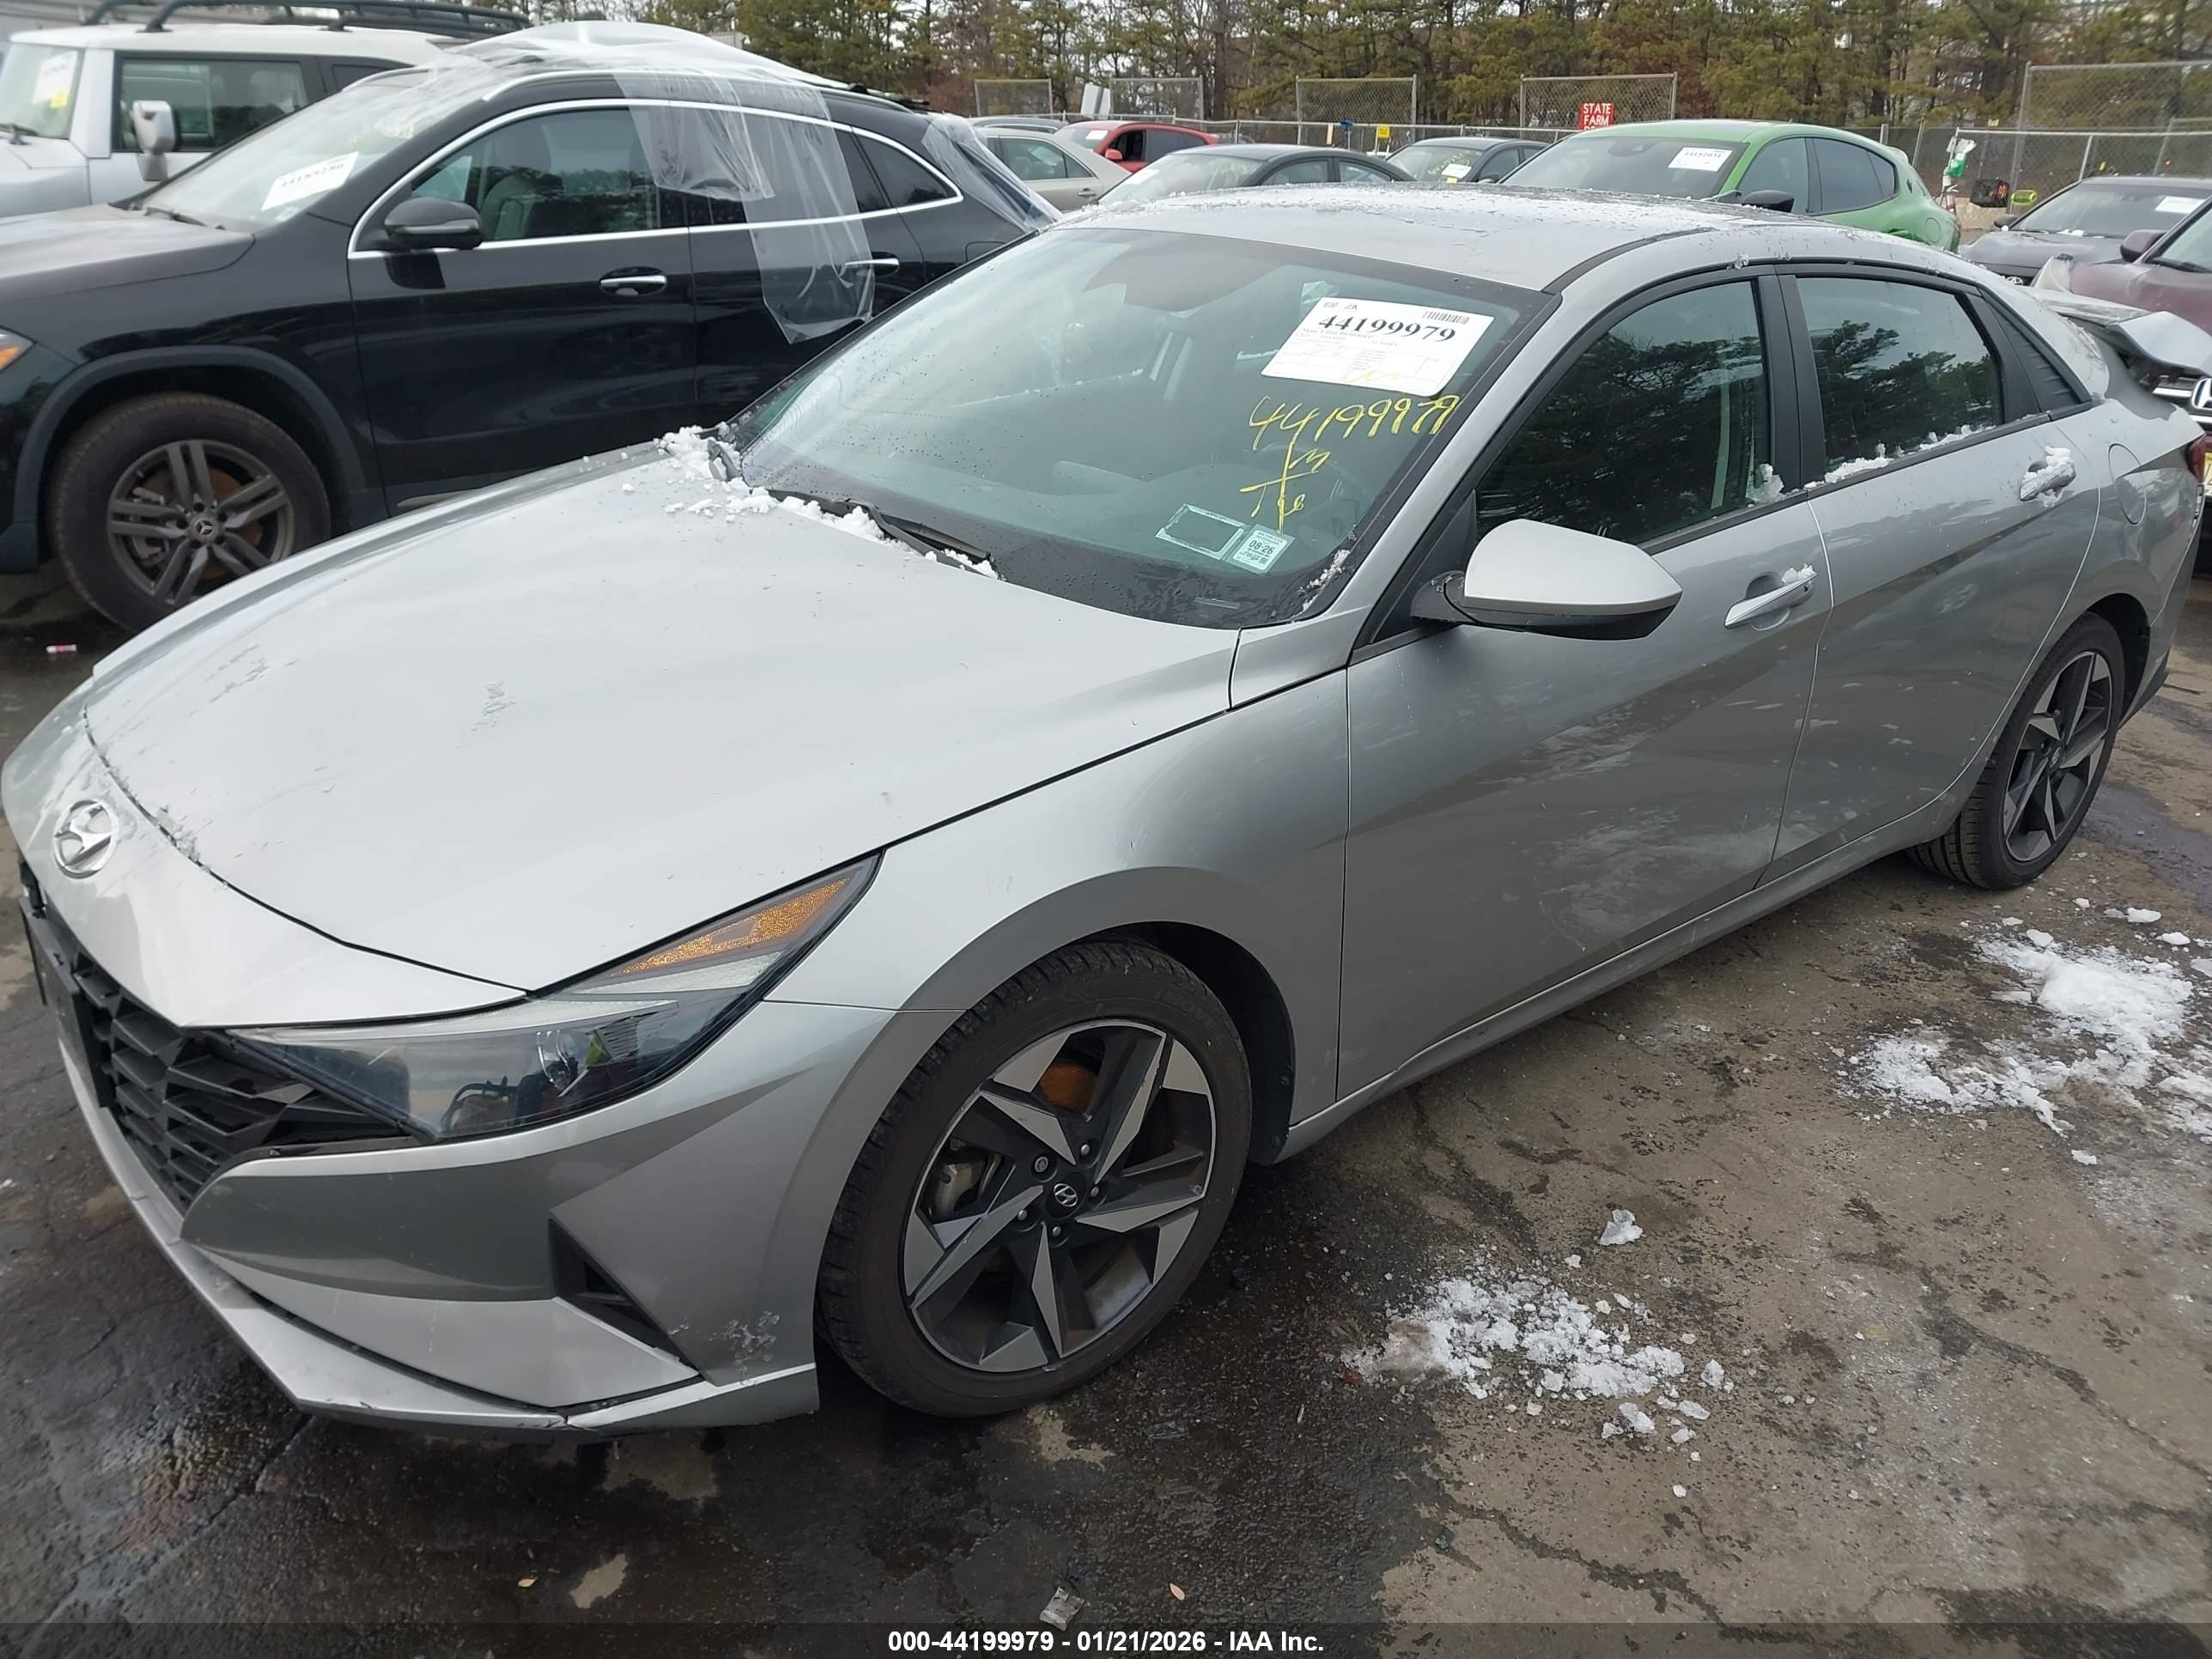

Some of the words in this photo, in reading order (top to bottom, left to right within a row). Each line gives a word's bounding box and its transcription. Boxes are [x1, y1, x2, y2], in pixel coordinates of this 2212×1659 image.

[1583, 102, 1612, 114] STATE
[1583, 114, 1610, 126] FARM
[1318, 313, 1456, 343] 44199979
